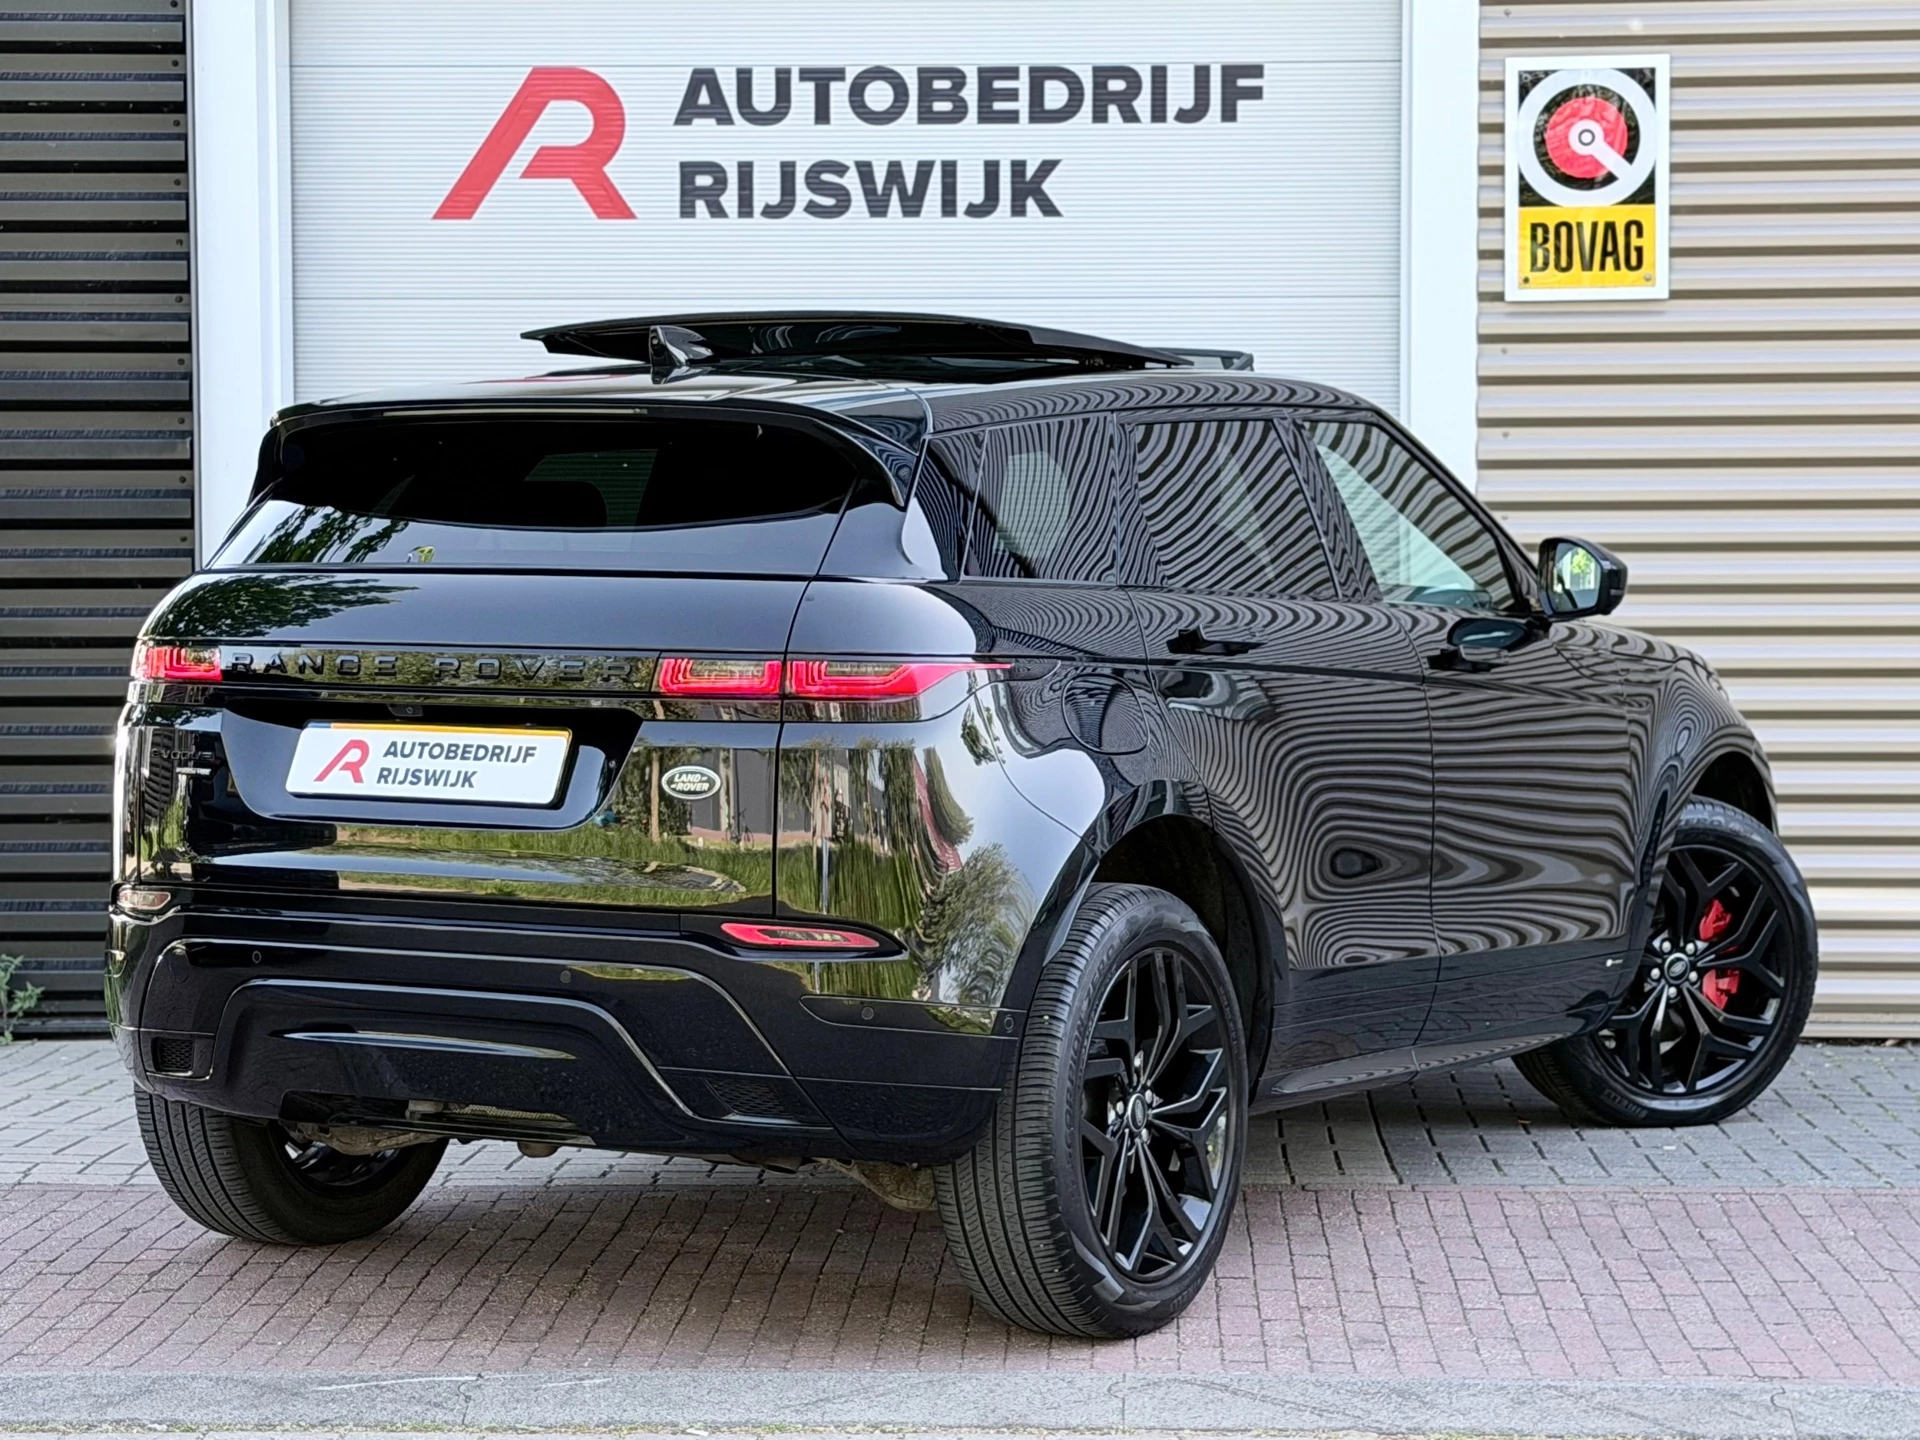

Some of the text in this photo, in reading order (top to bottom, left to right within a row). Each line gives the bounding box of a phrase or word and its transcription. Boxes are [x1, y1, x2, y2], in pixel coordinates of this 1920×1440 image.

[673, 64, 1264, 126] AUTOBEDRIJF
[679, 159, 1064, 220] RIJSWIJK
[1529, 219, 1644, 274] BOVAG
[230, 651, 635, 682] RANGE ROVER
[382, 740, 538, 764] AUTOBEDRIJF
[376, 766, 479, 789] RIJSWIJK
[673, 773, 702, 783] LAND
[675, 782, 710, 792] ROVER
